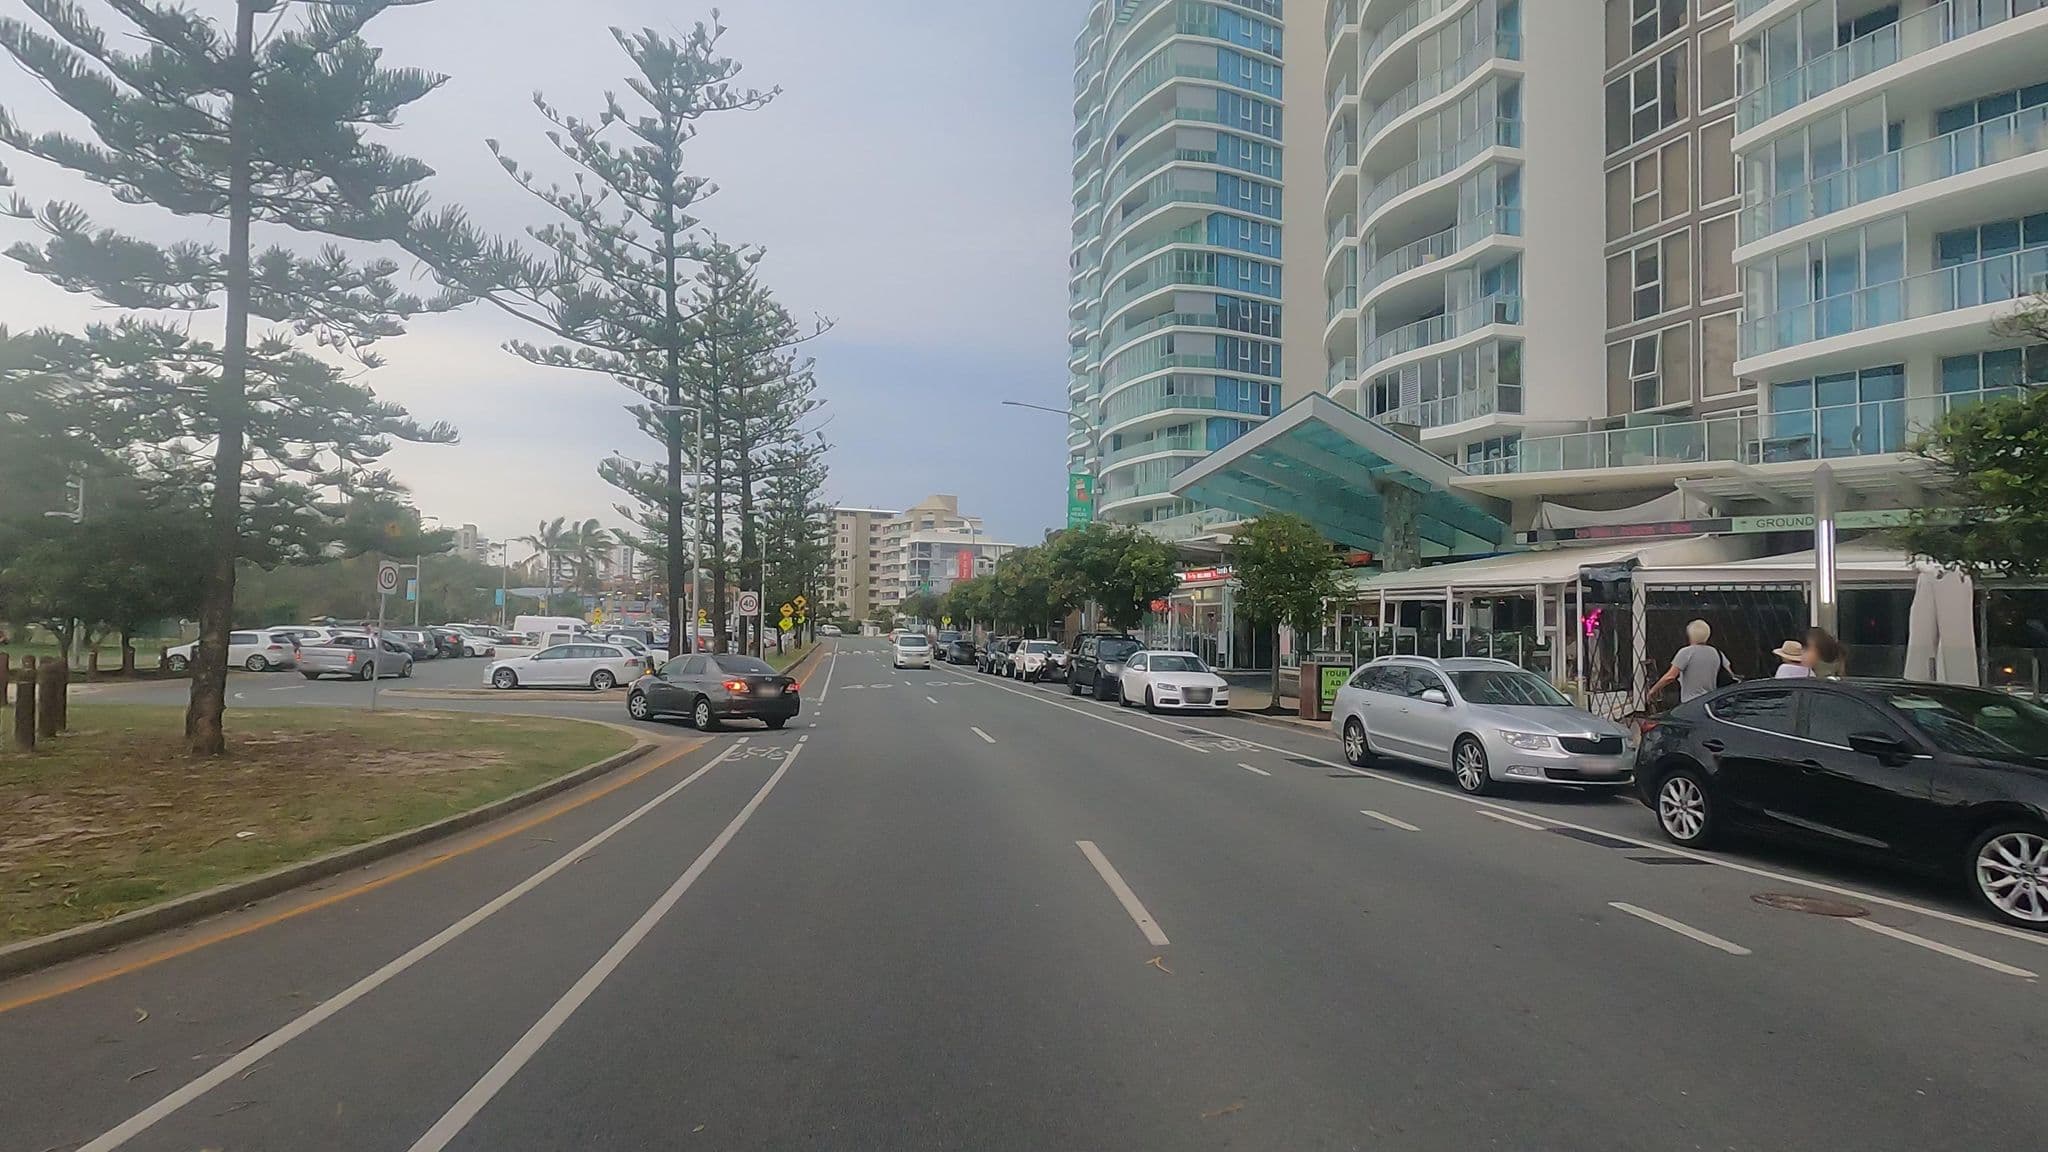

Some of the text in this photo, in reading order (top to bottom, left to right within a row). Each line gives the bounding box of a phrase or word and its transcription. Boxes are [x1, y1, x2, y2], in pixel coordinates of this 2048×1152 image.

[1755, 516, 1815, 529] GROUND
[383, 571, 394, 584] 10
[742, 599, 754, 608] 40
[1330, 679, 1342, 687] AD
